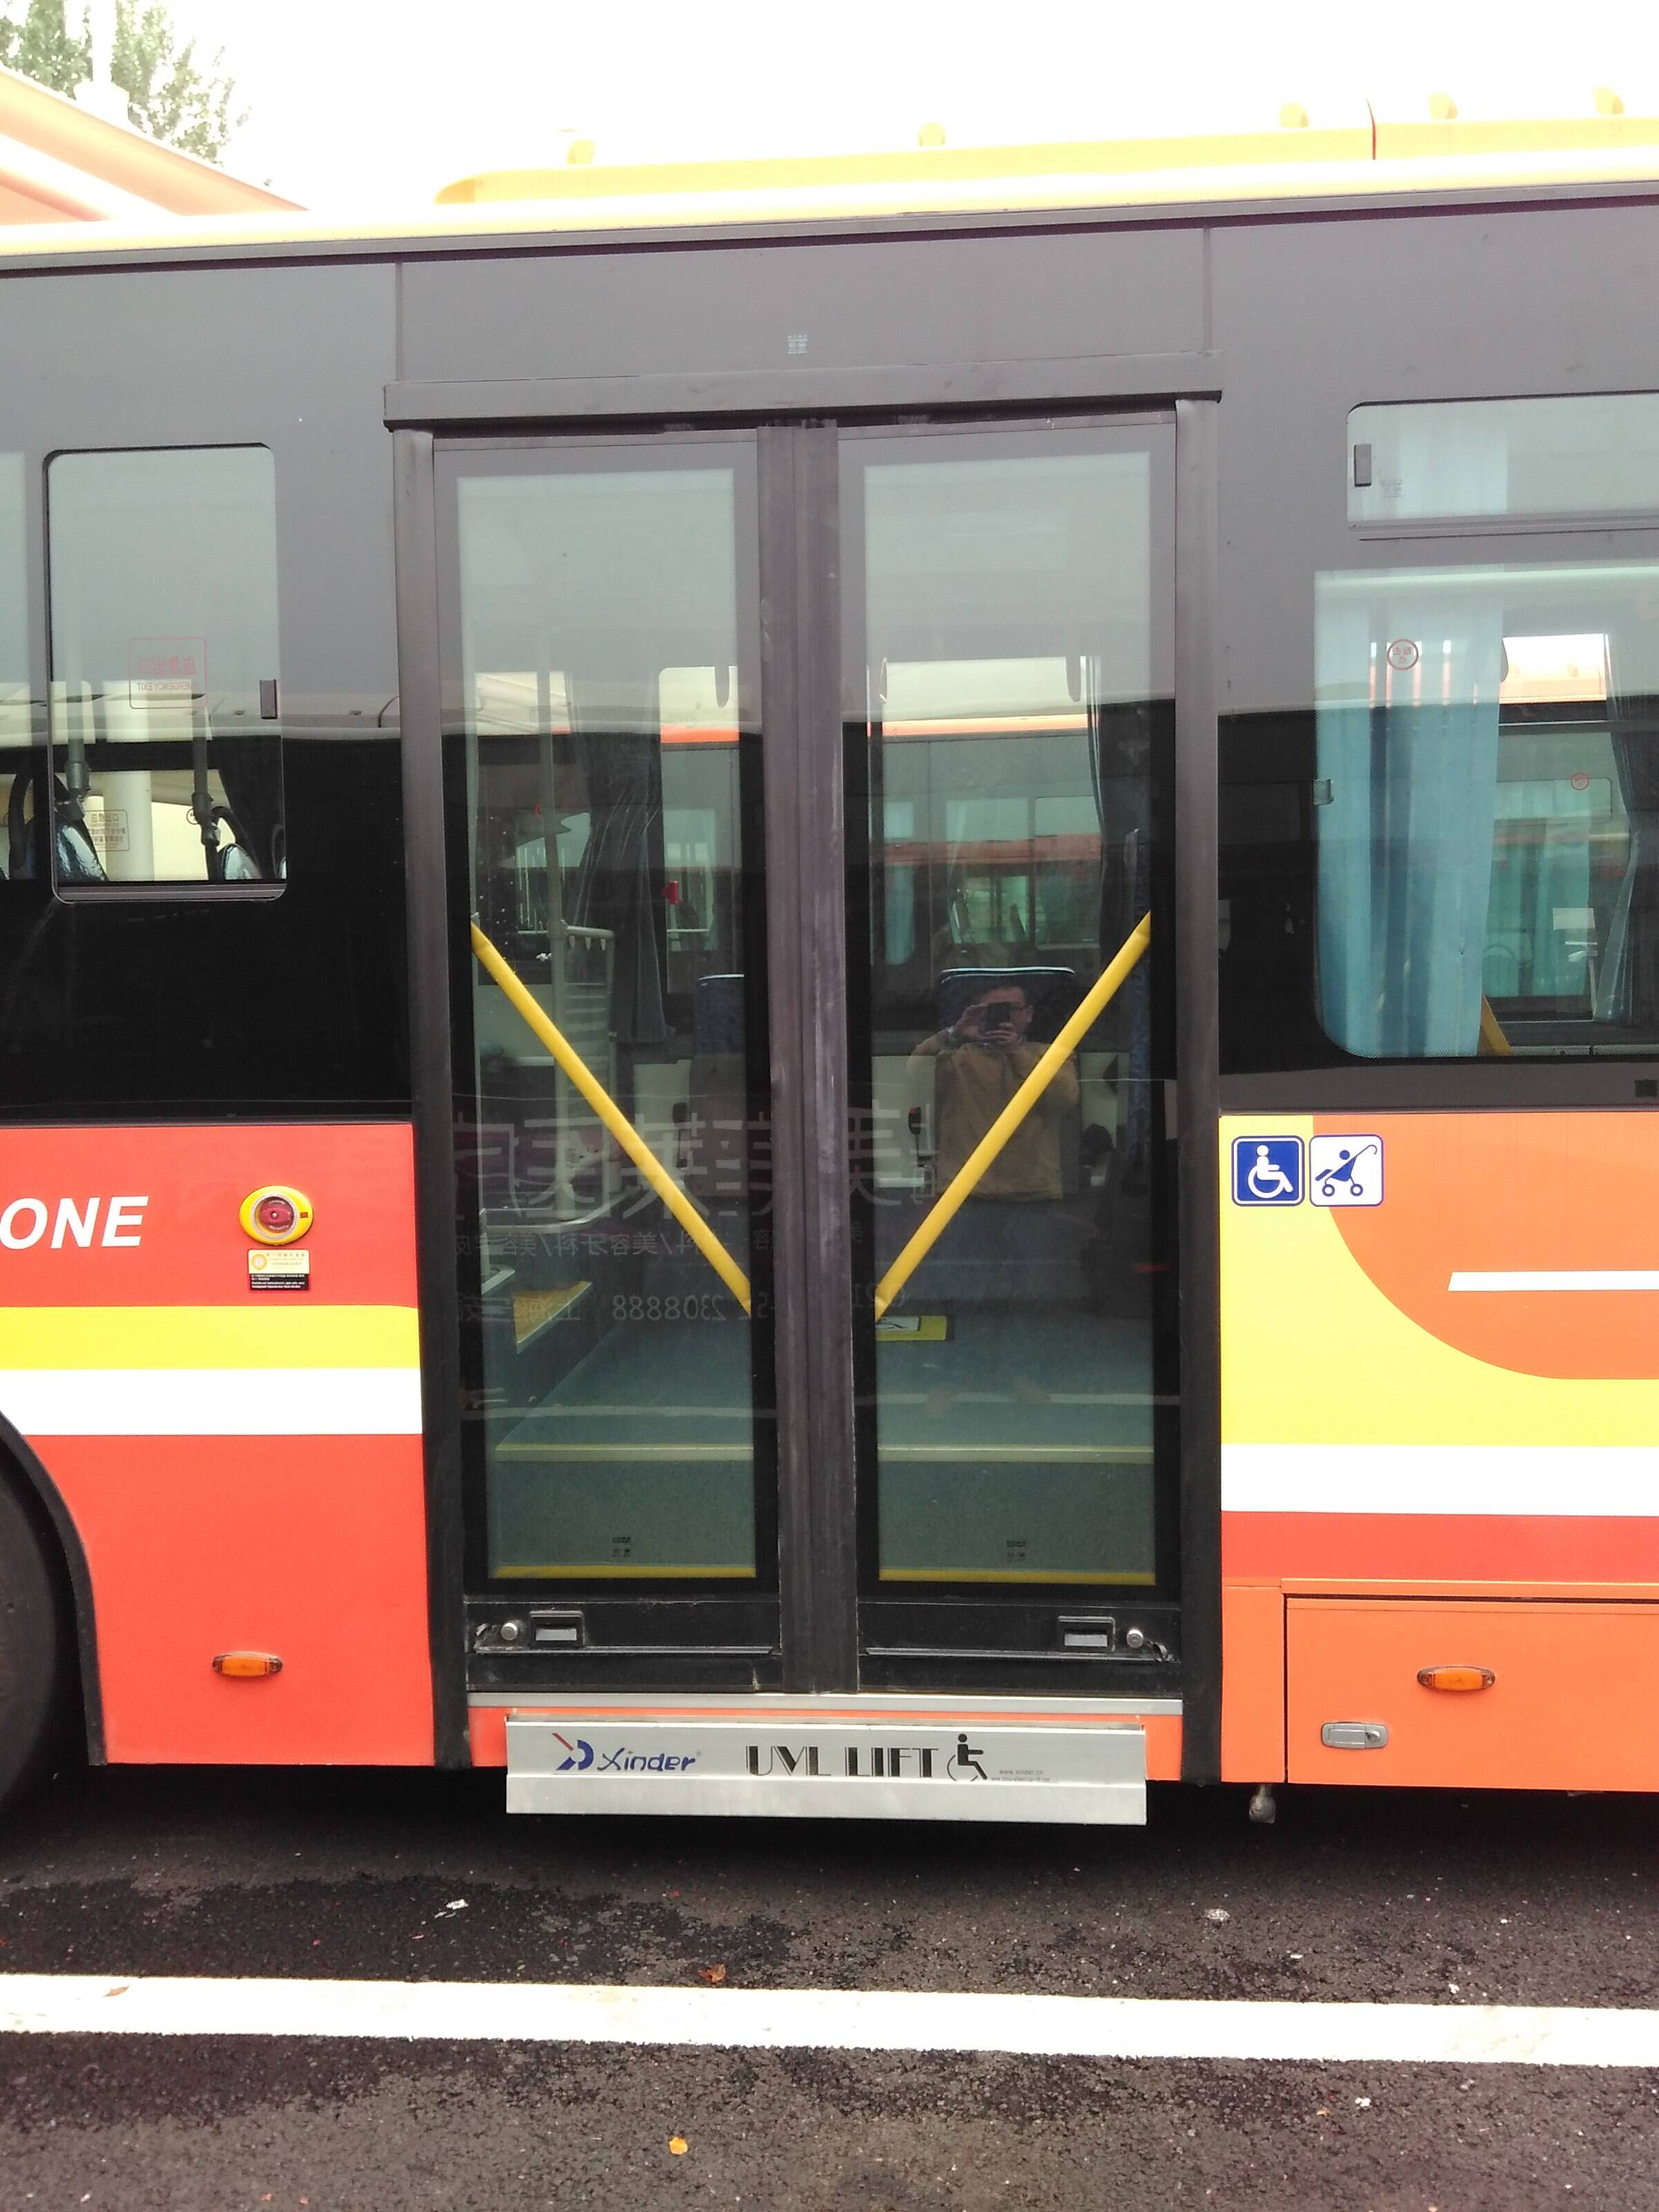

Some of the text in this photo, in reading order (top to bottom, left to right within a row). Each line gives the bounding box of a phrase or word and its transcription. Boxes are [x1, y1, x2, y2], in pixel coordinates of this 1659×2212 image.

[0, 1196, 149, 1250] ONE
[597, 1747, 696, 1772] Xinder
[745, 1745, 939, 1778] UVL LIFT
